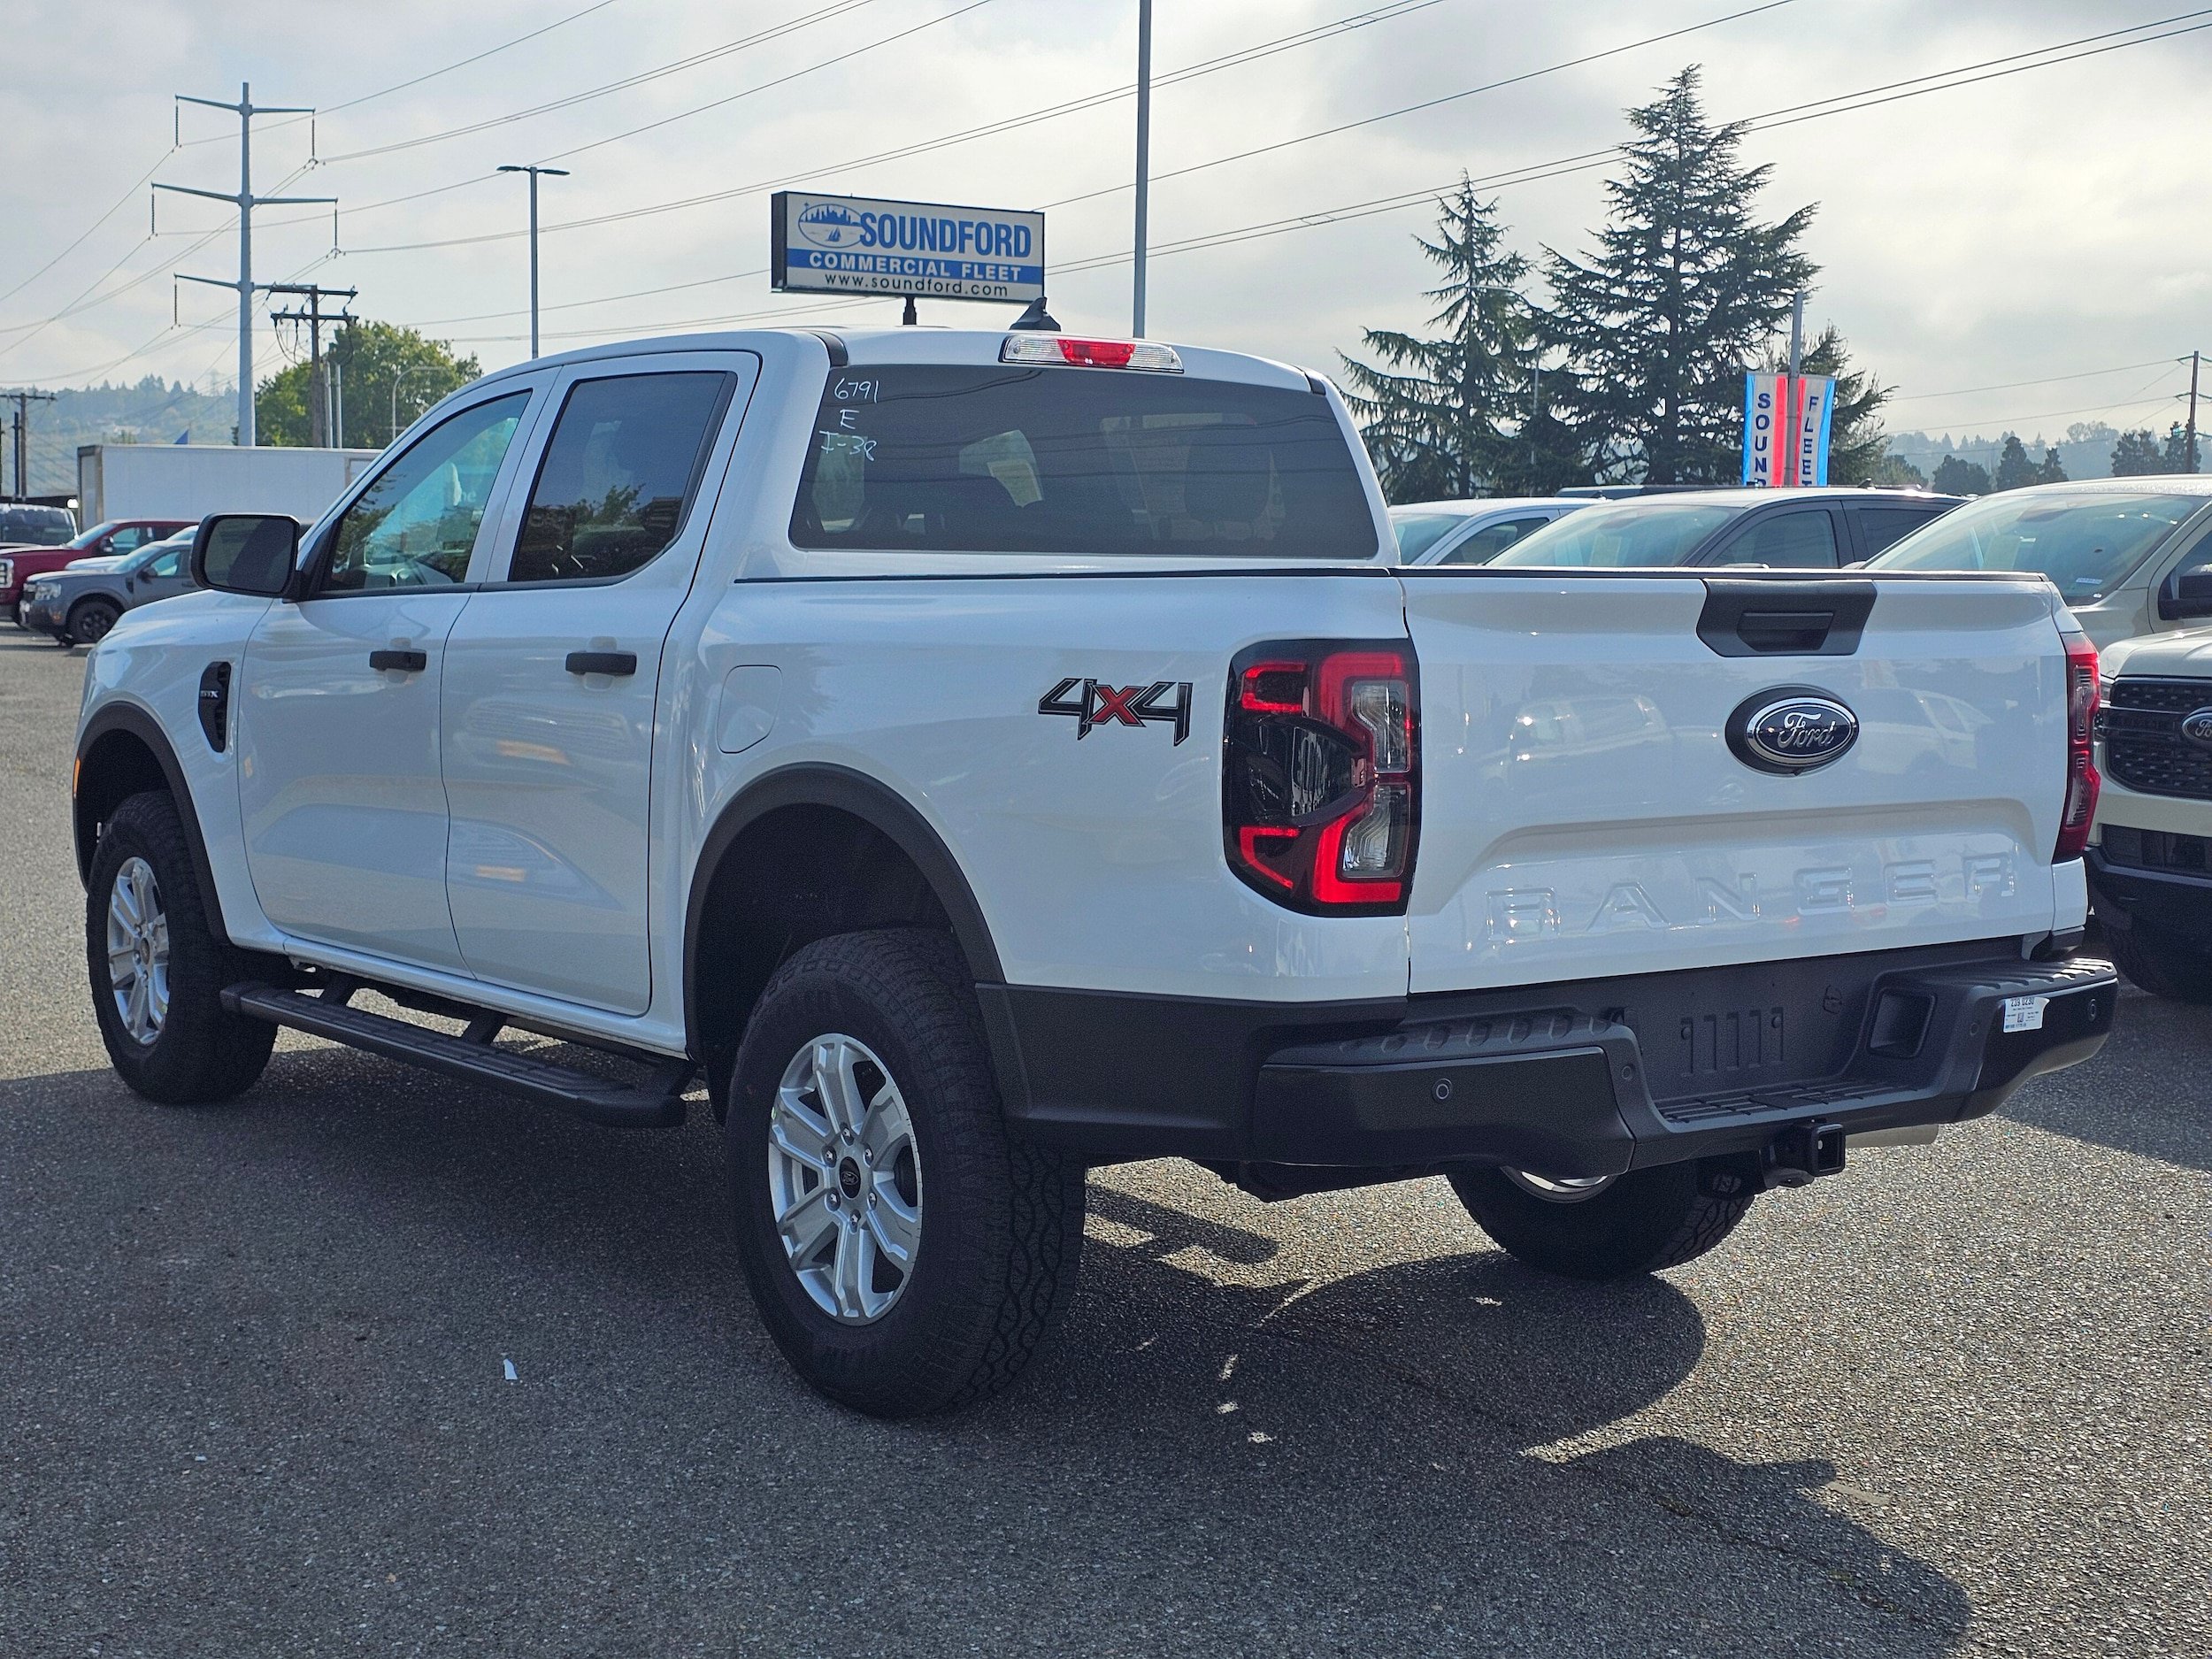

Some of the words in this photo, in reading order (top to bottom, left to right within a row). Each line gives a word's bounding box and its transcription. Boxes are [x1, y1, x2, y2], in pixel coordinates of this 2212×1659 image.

[860, 211, 1031, 258] SOUNDFORD
[809, 251, 950, 276] COMMERCIAL
[962, 263, 1021, 281] FLEET
[825, 273, 1008, 296] www.soundford.com
[834, 377, 879, 403] 6791
[840, 409, 860, 429] E
[1777, 712, 1836, 749] Ford
[2195, 718, 2212, 738] Fo
[1486, 855, 2015, 942] RANGER
